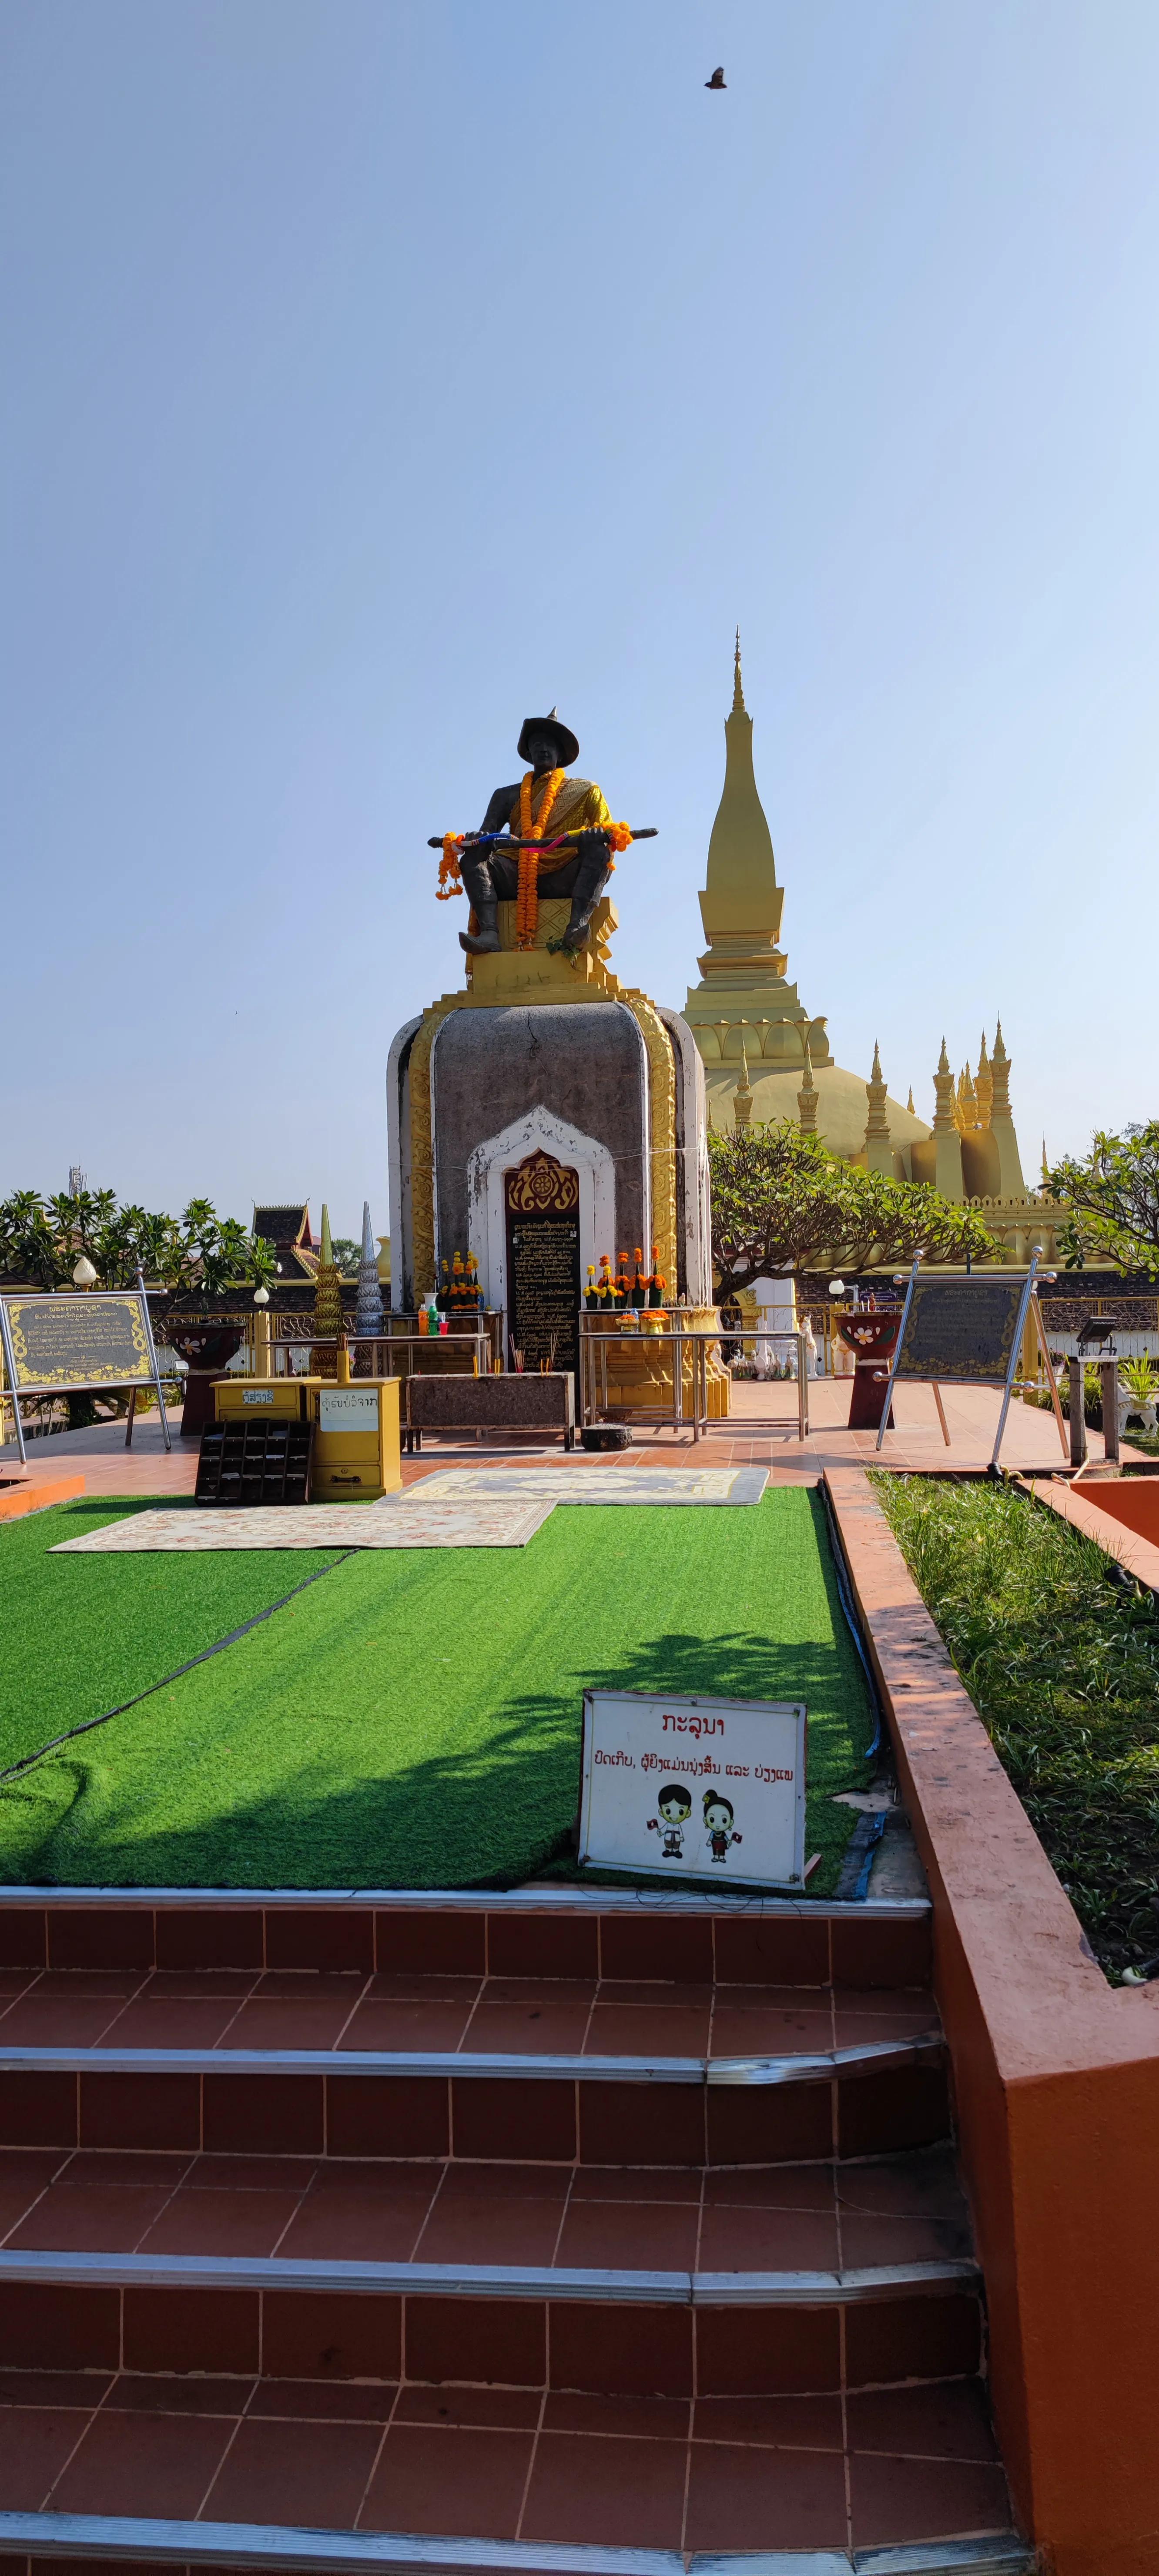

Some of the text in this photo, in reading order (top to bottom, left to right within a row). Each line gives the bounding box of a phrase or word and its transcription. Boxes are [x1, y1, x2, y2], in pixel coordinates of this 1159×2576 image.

[662, 1714, 724, 1740] ກະລຸນາ
[725, 1764, 750, 1777] ແລະ
[754, 1764, 793, 1783] ບ່ຽງແພ
